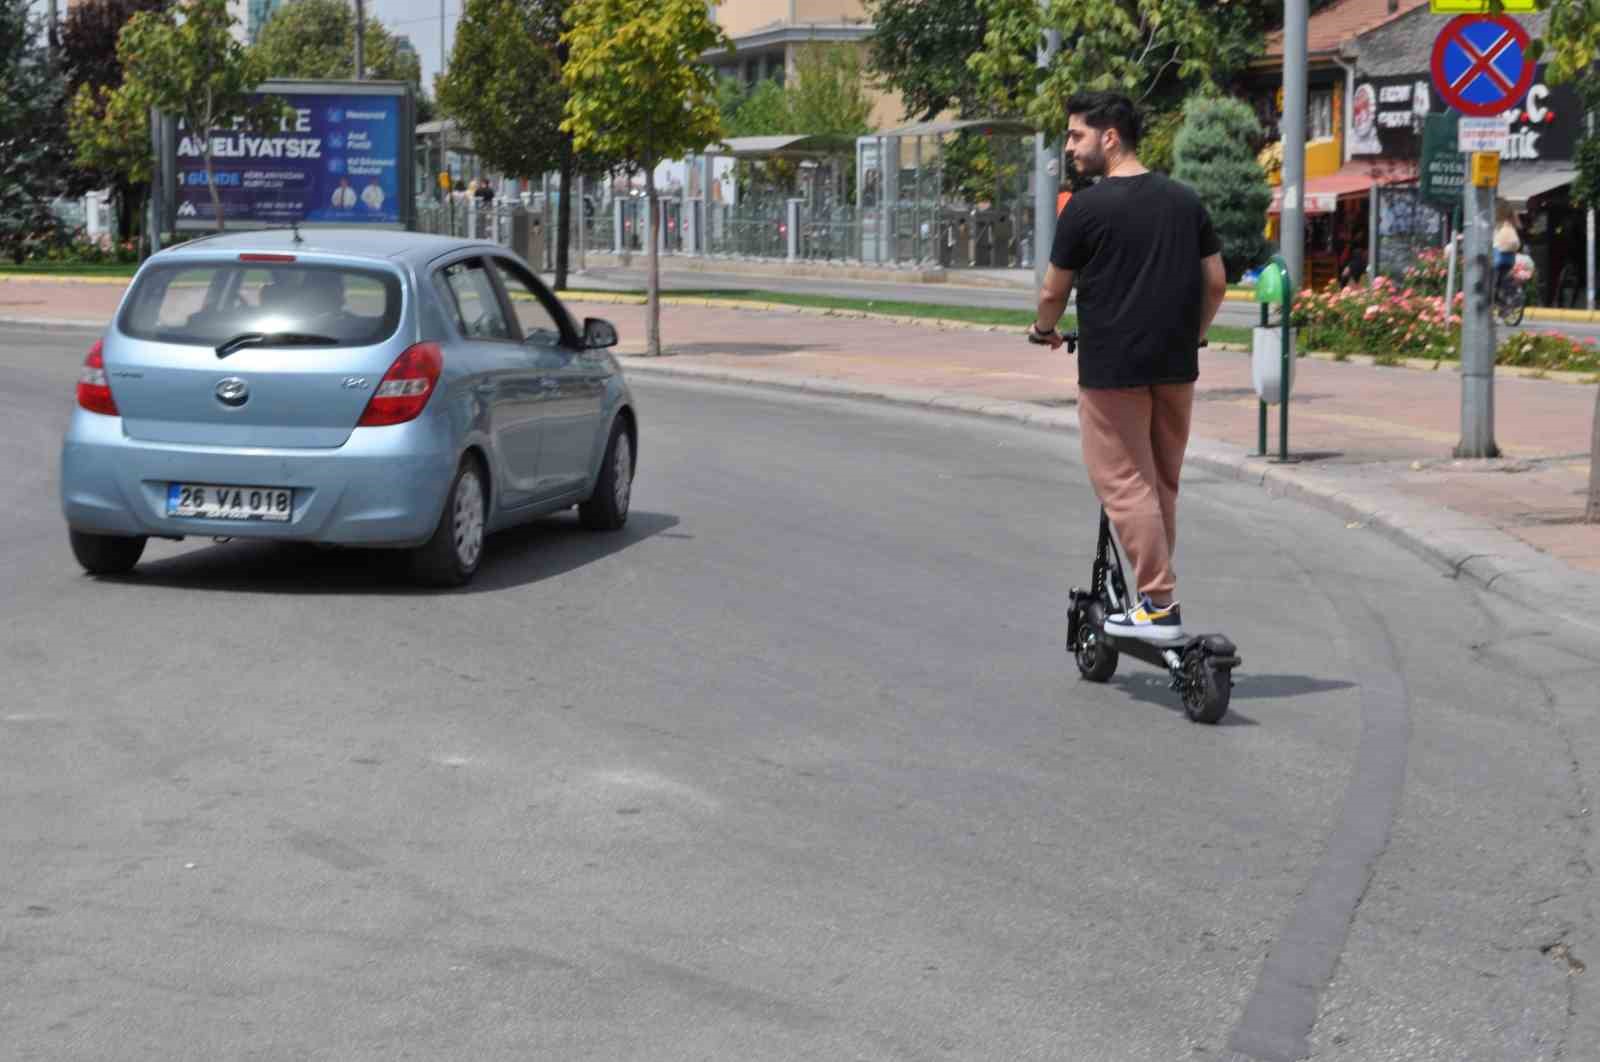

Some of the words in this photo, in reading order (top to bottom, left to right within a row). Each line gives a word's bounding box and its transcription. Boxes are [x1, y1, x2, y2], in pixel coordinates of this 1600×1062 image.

[180, 486, 206, 508] 26
[215, 489, 242, 509] VA
[249, 490, 289, 512] 018
